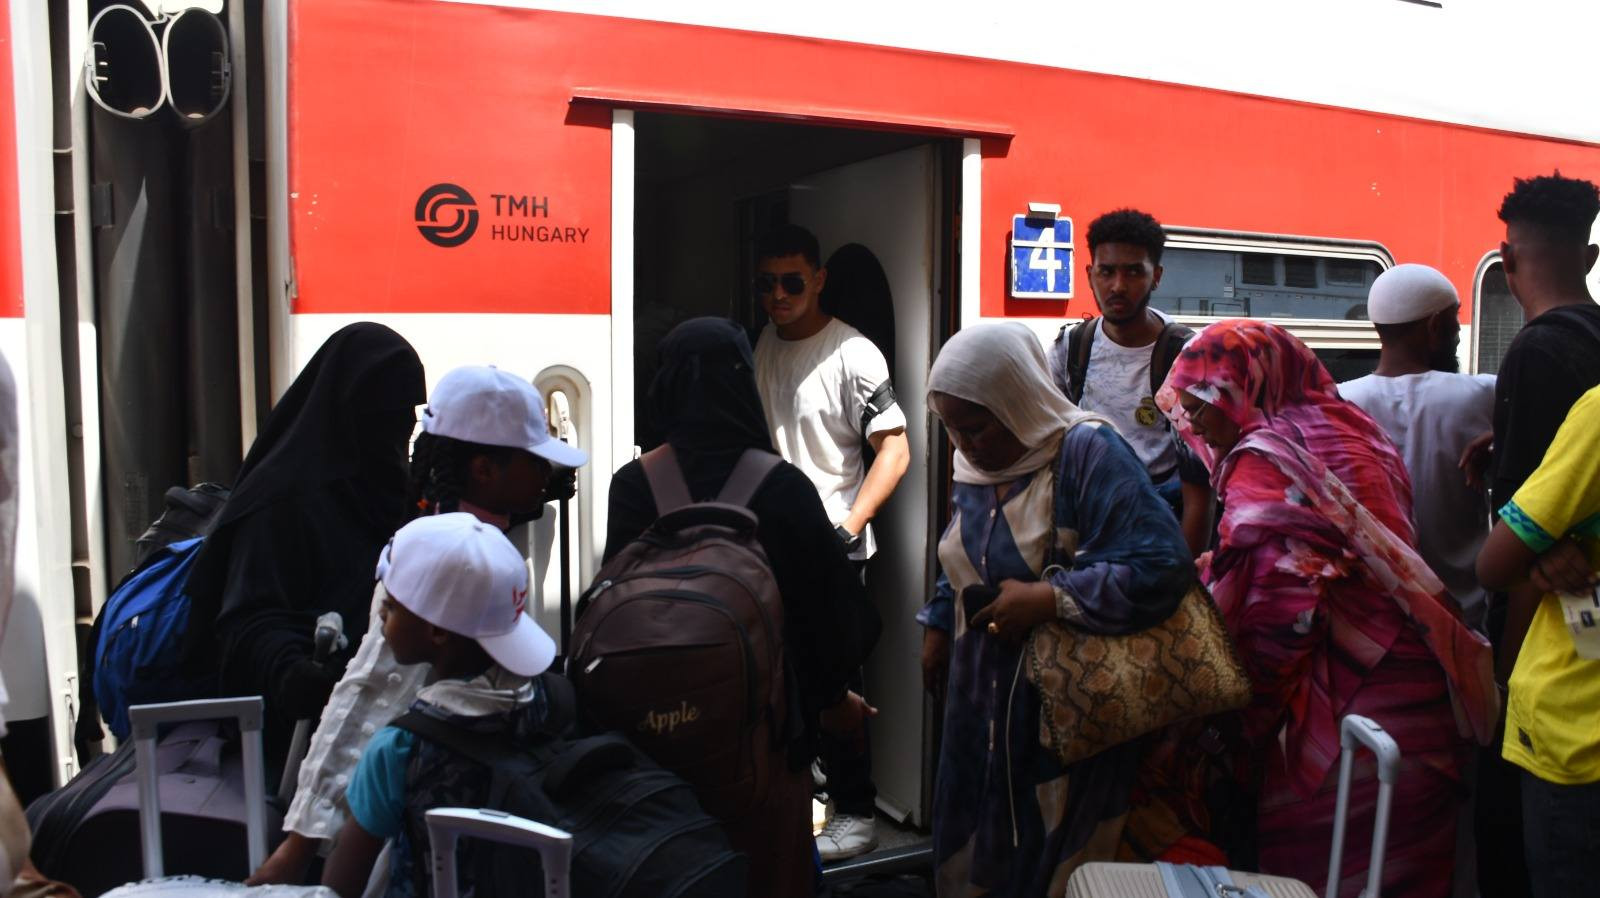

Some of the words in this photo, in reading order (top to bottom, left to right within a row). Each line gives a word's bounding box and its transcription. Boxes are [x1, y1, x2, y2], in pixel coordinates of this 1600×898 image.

[490, 194, 548, 218] TMH
[492, 224, 590, 243] HUNGARY
[1028, 226, 1062, 293] 4
[637, 700, 700, 735] Apple
